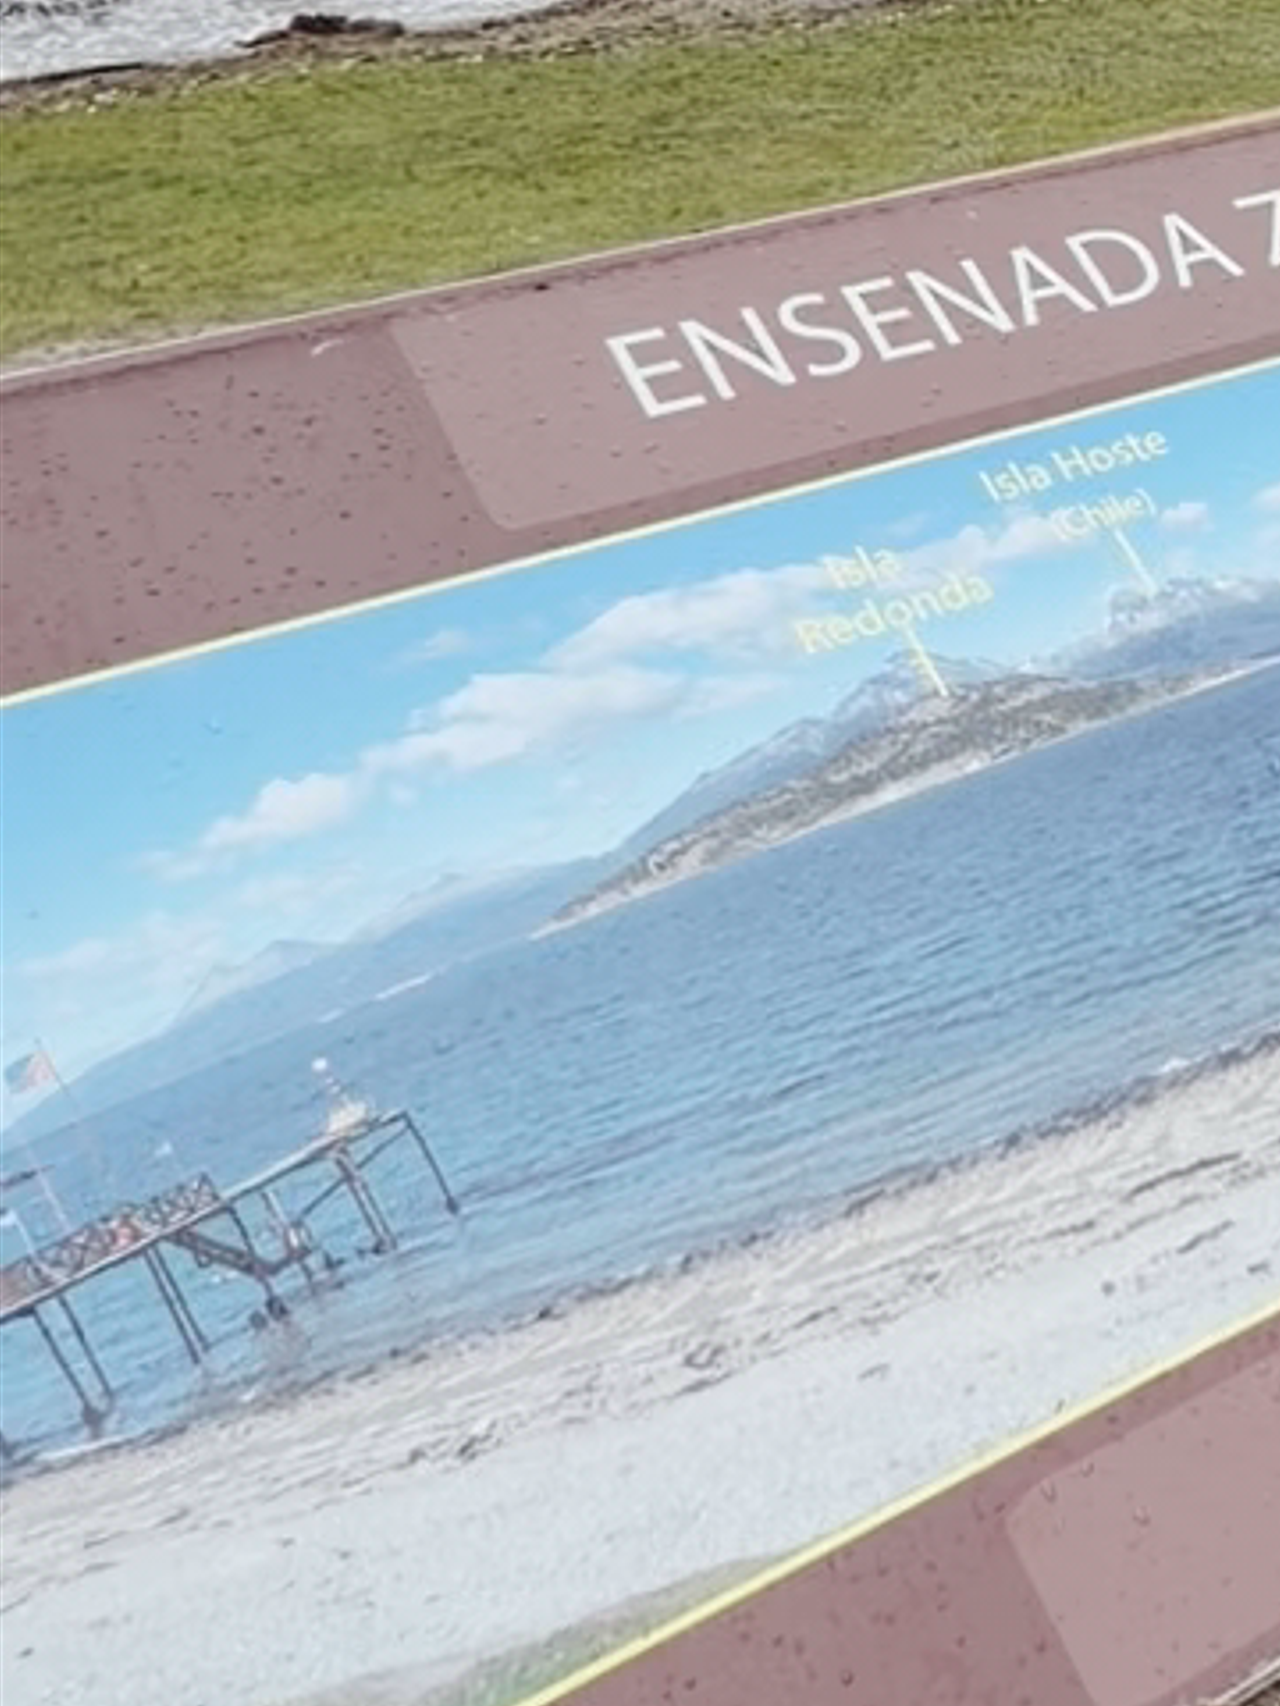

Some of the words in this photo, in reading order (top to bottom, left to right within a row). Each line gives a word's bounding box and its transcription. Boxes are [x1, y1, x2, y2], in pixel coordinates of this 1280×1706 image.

[605, 213, 1245, 418] ENSENADA
[979, 454, 1052, 503] Isla
[1050, 427, 1170, 484] Hoste
[1050, 487, 1157, 542] (Chile)
[821, 545, 899, 590] Isla
[792, 570, 995, 655] Redonda
